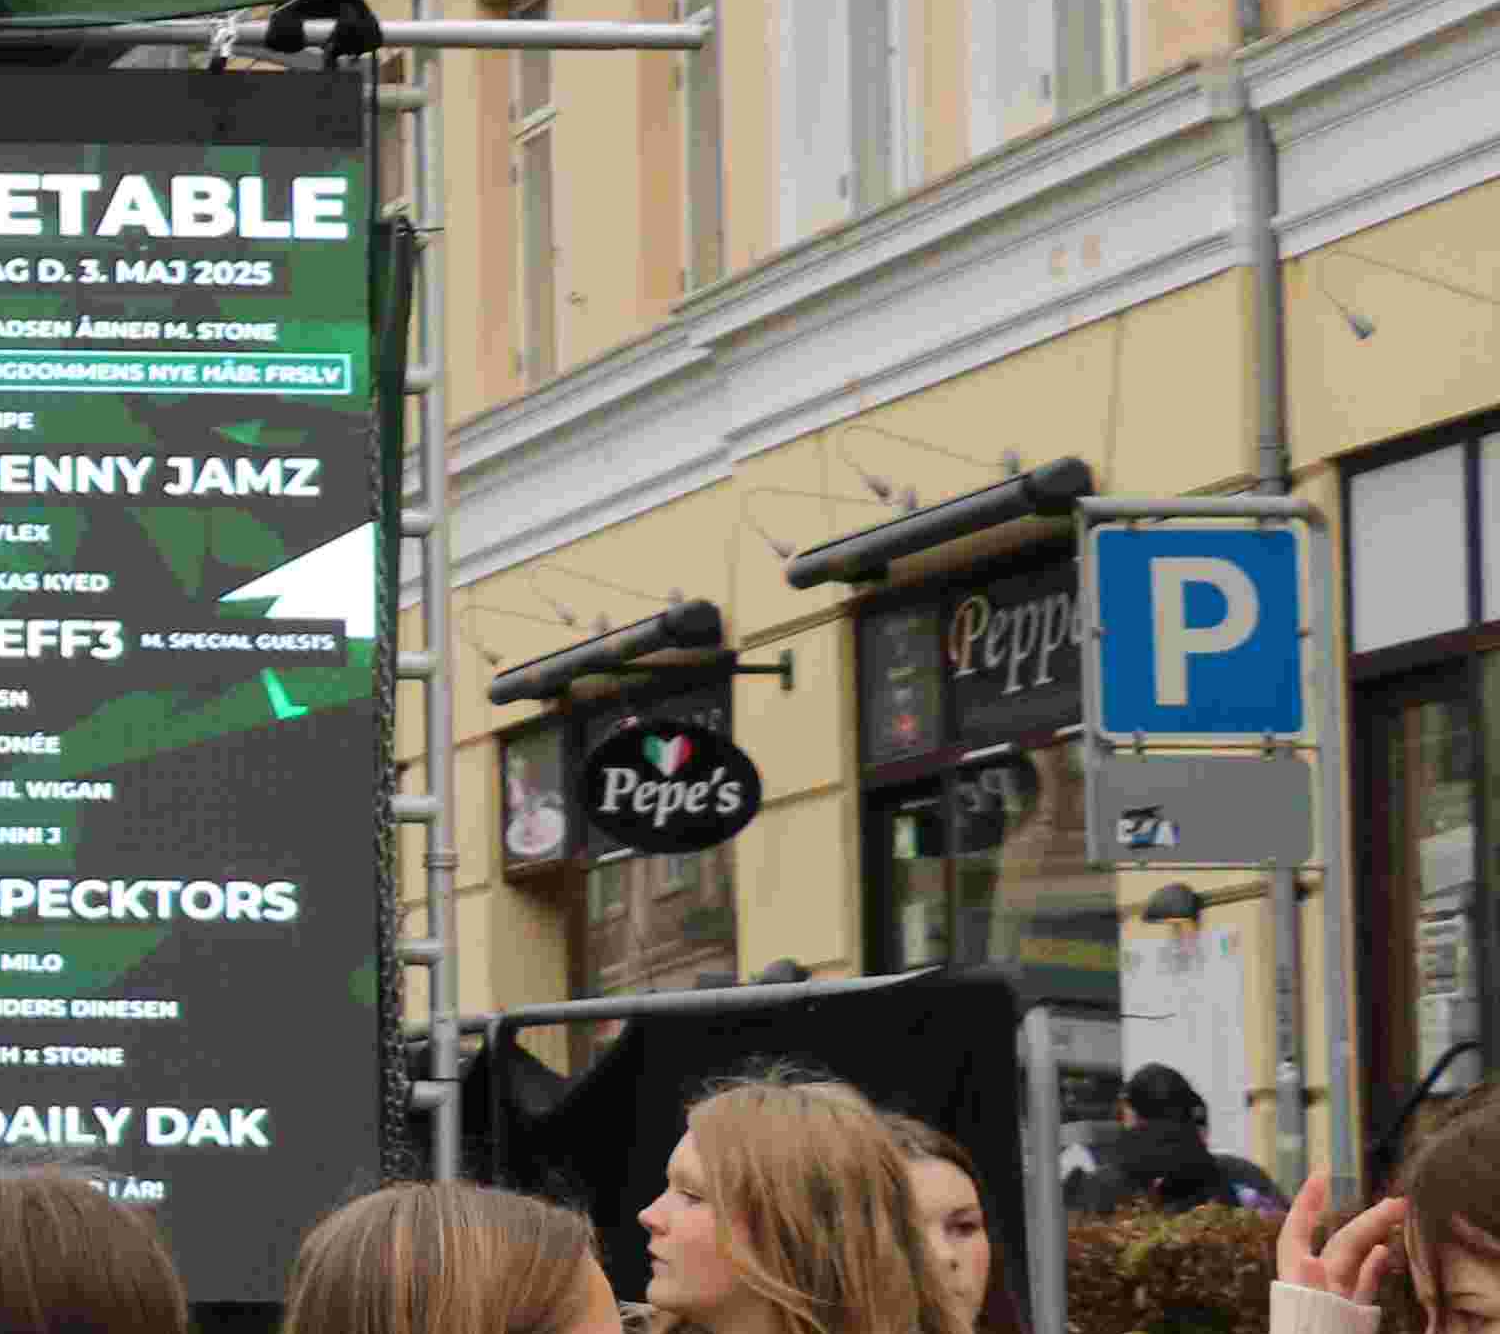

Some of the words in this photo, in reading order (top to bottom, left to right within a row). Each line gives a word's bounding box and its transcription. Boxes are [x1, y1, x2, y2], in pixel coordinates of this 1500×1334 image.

[37, 258, 73, 283] D.
[78, 259, 108, 284] 3.
[115, 259, 187, 285] MAJ
[193, 260, 272, 286] 2025
[75, 314, 161, 340] ÅBNER
[163, 321, 194, 340] M.
[196, 321, 277, 342] STONE
[148, 364, 197, 382] NYE
[163, 456, 321, 497] JAMZ
[43, 573, 109, 593] KYED
[141, 633, 165, 649] M.
[168, 632, 253, 650] SPECIAL
[255, 633, 336, 650] GUESTS
[1150, 556, 1260, 707] P
[25, 781, 113, 801] WIGAN
[597, 766, 742, 828] Pepe's
[46, 827, 61, 845] J
[0, 953, 63, 972] MILO
[71, 999, 178, 1018] DINESEN
[42, 1046, 125, 1066] STONE
[146, 1107, 269, 1147] DAK
[121, 1175, 165, 1200] ÅR!
